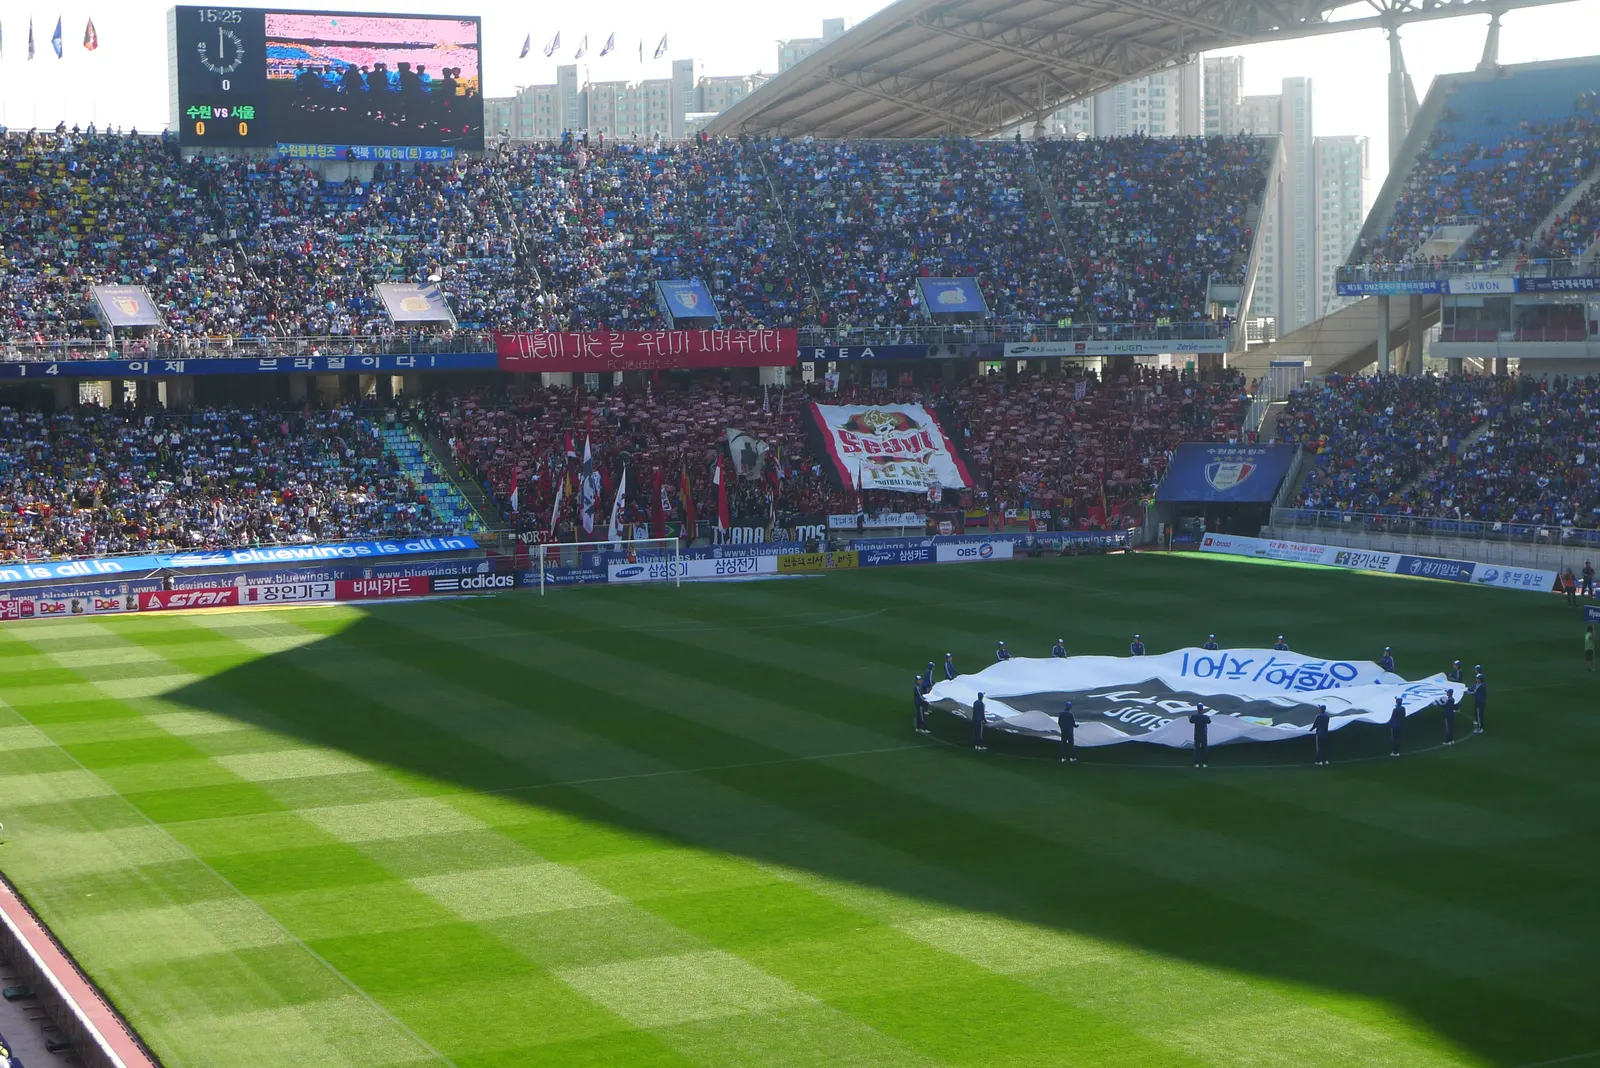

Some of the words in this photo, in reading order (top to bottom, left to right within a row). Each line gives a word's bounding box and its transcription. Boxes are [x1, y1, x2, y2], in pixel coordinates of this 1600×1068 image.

[198, 9, 242, 23] 15:25
[222, 80, 230, 90] 0
[187, 106, 211, 118] 수원
[231, 106, 255, 119] 서울
[196, 122, 205, 135] 0
[239, 122, 248, 135] 0
[279, 145, 336, 157] 수원블루윙즈
[425, 151, 438, 159] 오후
[1465, 282, 1499, 290] SUWON
[502, 333, 564, 360] 그대들이
[570, 333, 602, 358] 가는
[609, 333, 625, 358] 길
[638, 331, 689, 356] 우리가
[698, 329, 782, 353] 지켜주리라
[234, 542, 371, 563] bluewings
[375, 542, 396, 554] is
[405, 537, 435, 552] all
[441, 538, 466, 549] in
[724, 545, 808, 558] www.bluewings.
[900, 550, 928, 561] 삼성카드
[608, 552, 706, 565] wwwbluewings.kr
[715, 557, 758, 574] 삼성전기
[1351, 552, 1390, 570] 경기신문
[23, 564, 52, 578] is
[56, 560, 92, 576] all
[93, 560, 122, 573] in
[649, 562, 688, 578] 삼성SDI
[1422, 561, 1460, 577] 경기일보
[248, 570, 344, 585] www.bluewings.kr
[461, 573, 514, 589] adidas
[1502, 570, 1543, 587] 중부일보
[263, 584, 330, 601] 장인가구
[353, 578, 411, 595] 비씨카드
[41, 602, 65, 612] Dole
[95, 599, 119, 609] Dole
[168, 591, 231, 607] star
[1181, 652, 1254, 680] 차이
